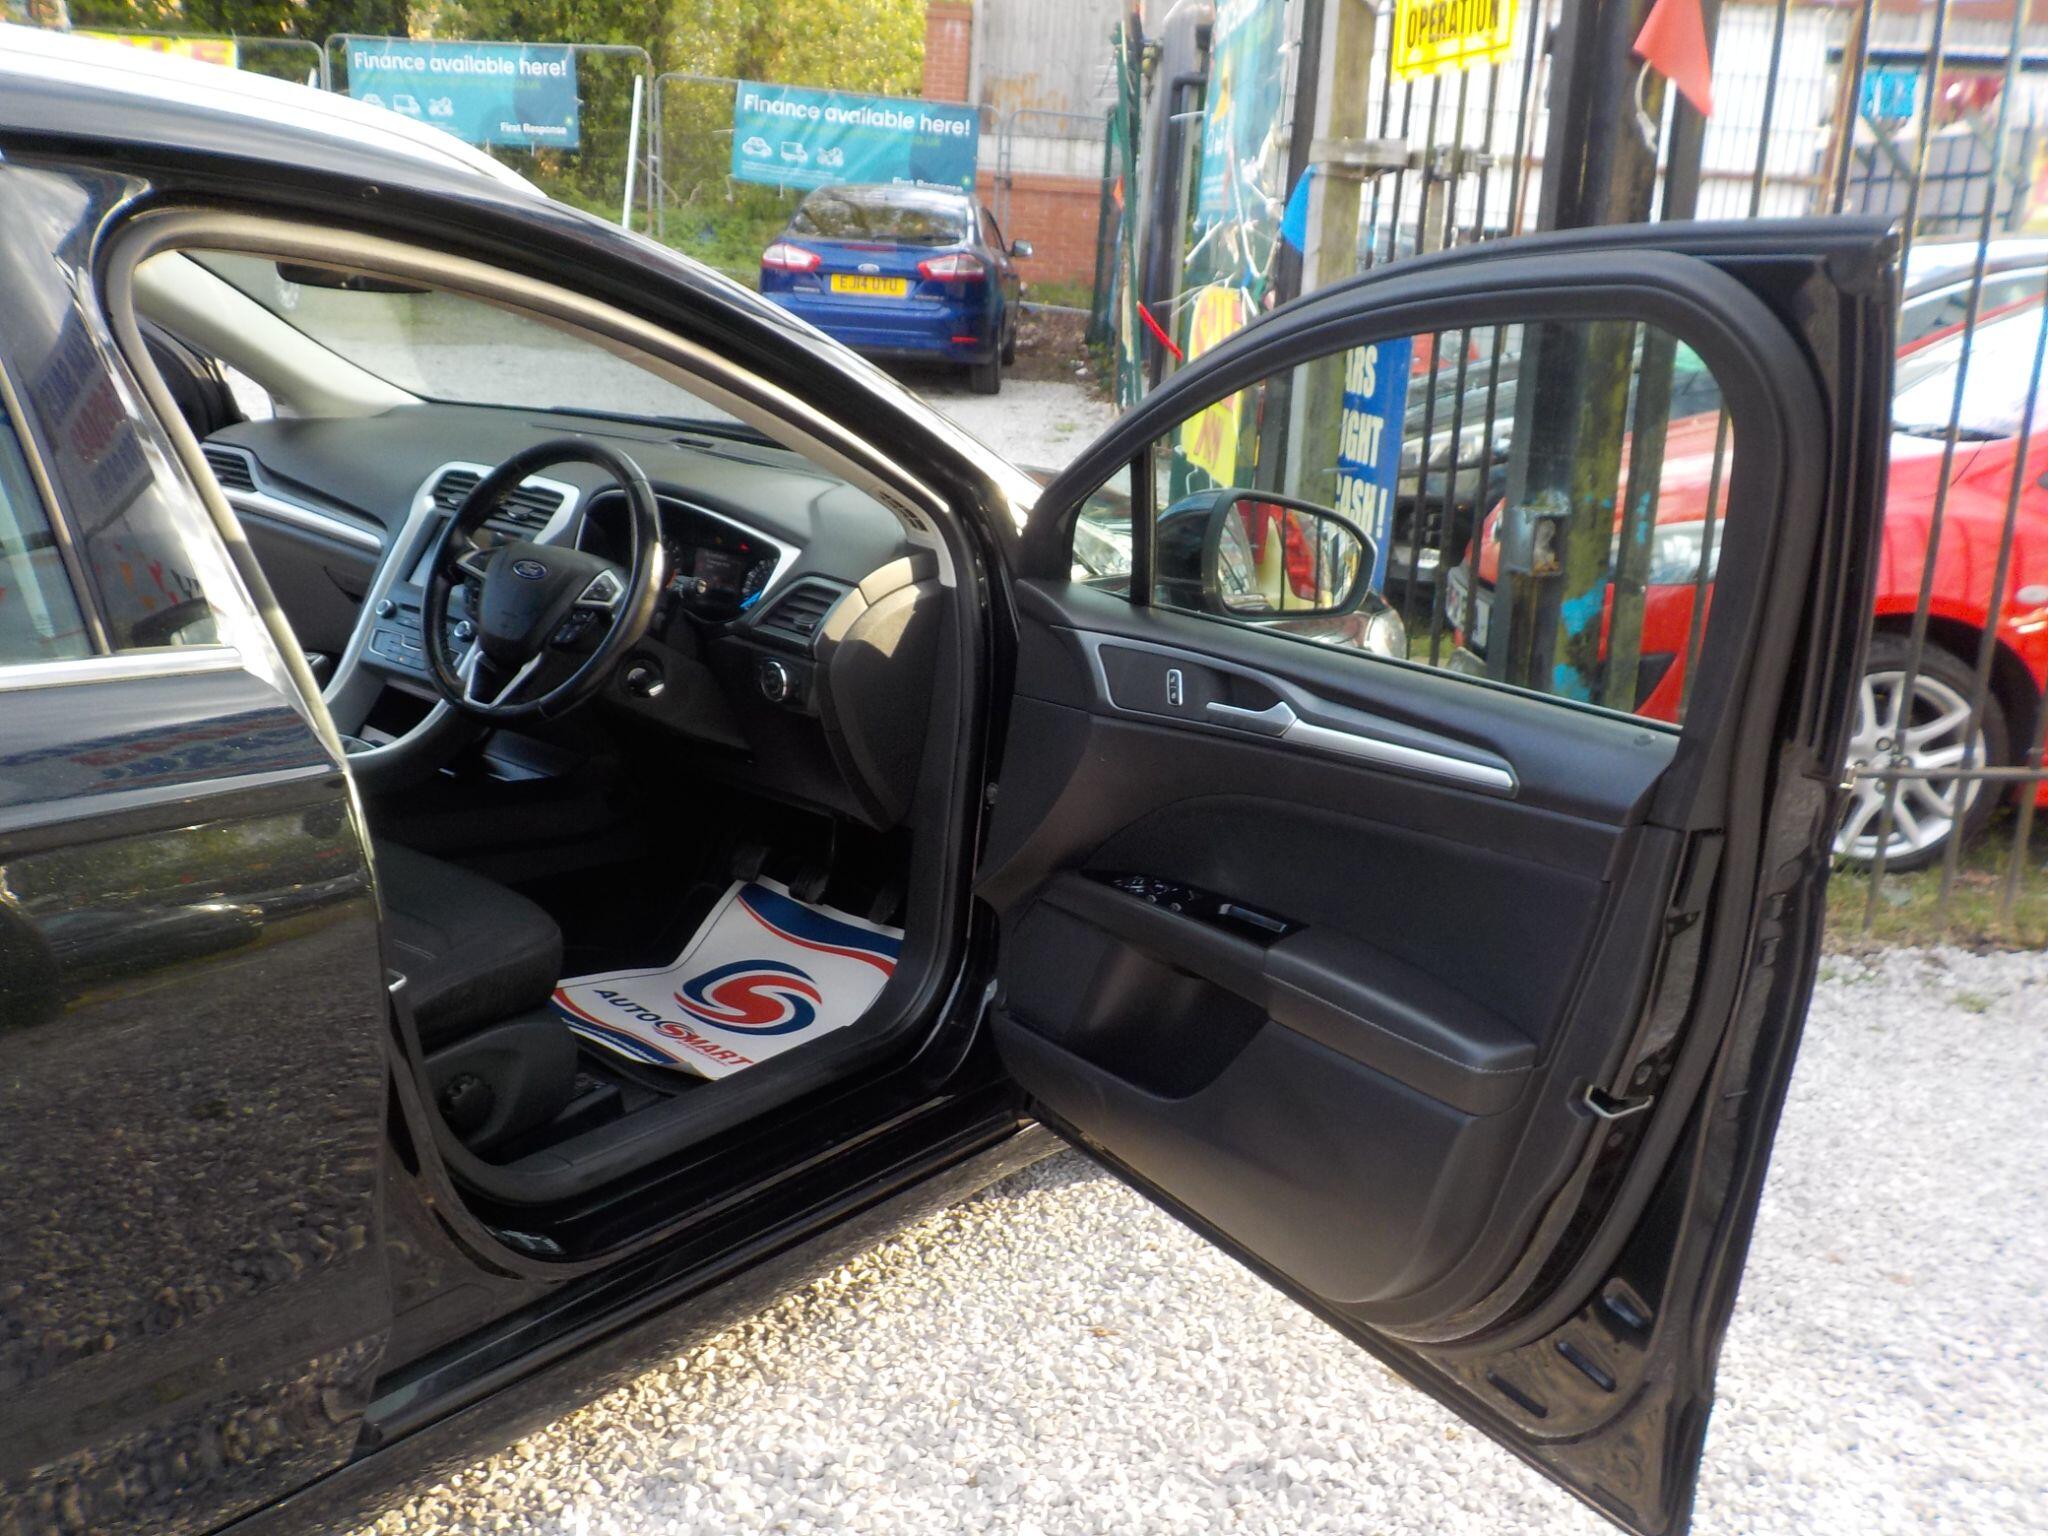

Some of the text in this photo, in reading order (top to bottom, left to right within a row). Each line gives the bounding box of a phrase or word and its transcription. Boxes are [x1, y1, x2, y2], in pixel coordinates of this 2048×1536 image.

[1406, 0, 1499, 48] OPERATION
[354, 52, 567, 76] Finance available here!
[744, 94, 820, 119] Finance
[824, 106, 914, 130] available
[919, 114, 971, 136] here!
